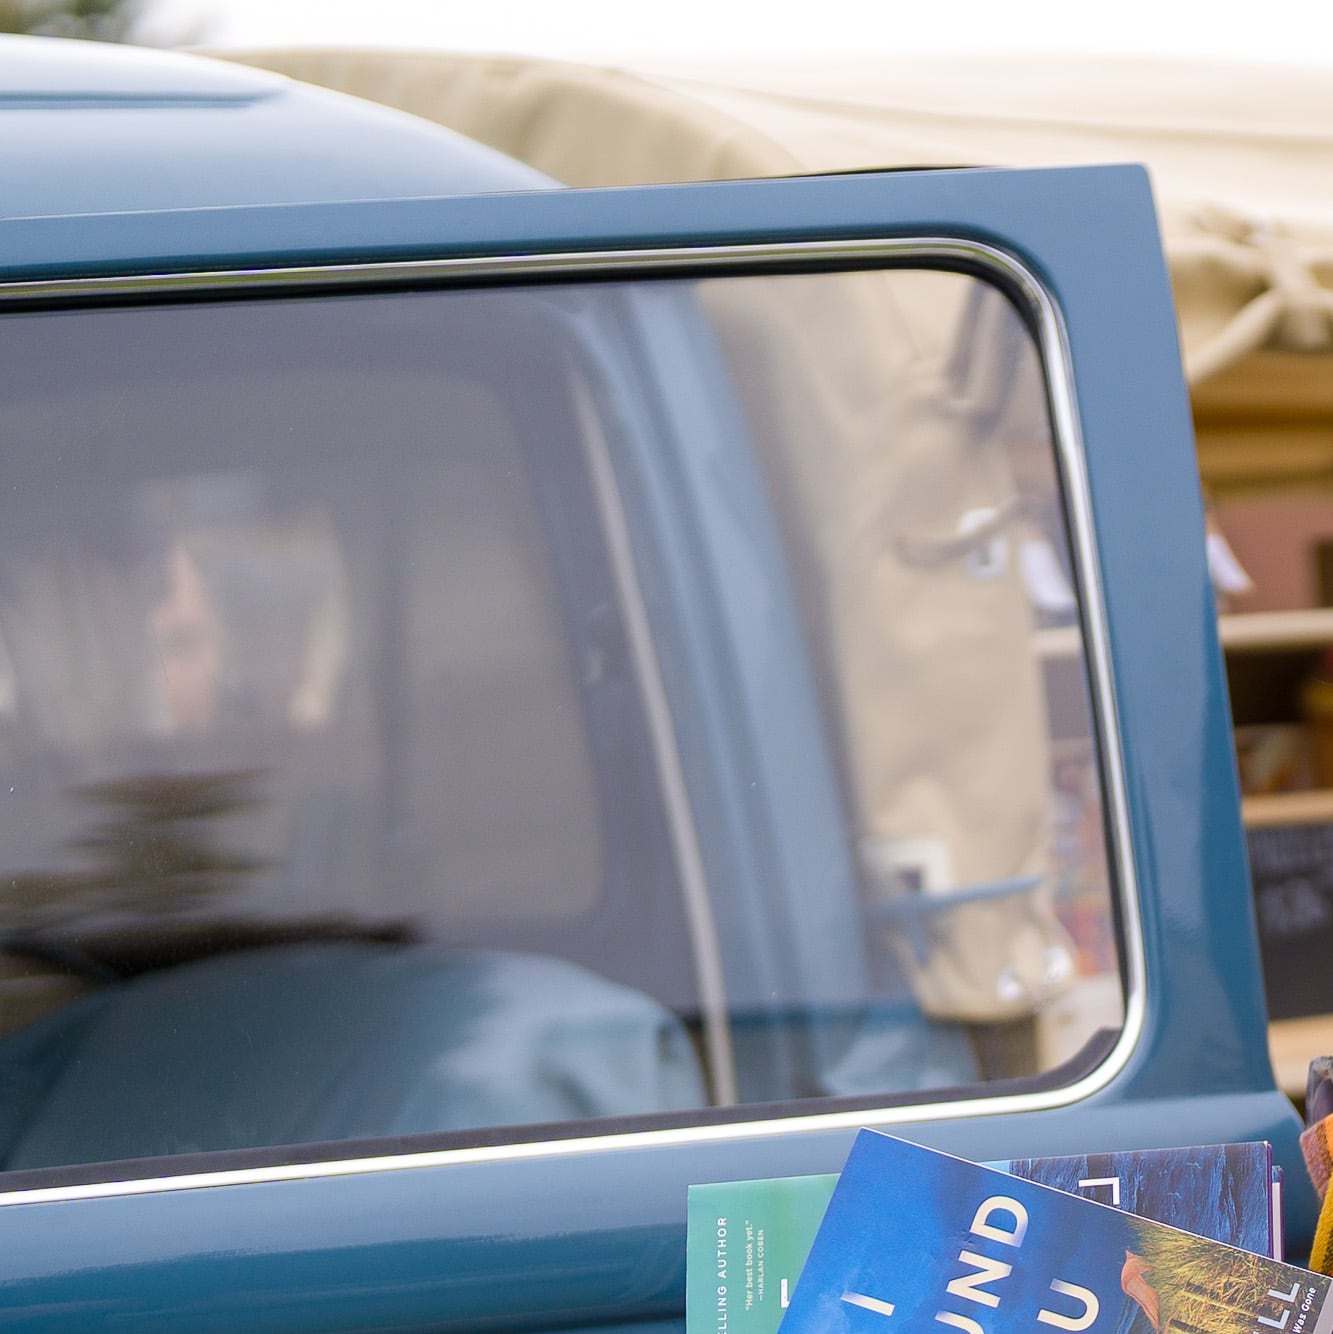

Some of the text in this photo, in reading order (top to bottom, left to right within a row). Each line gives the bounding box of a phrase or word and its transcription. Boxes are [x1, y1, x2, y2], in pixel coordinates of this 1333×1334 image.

[717, 1216, 728, 1279] AUTHOR
[745, 1243, 753, 1266] book
[757, 1229, 765, 1258] COBEN
[745, 1268, 753, 1288] best
[839, 1290, 896, 1317] I
[1291, 1313, 1307, 1334] Was
[1301, 1287, 1317, 1312] Gone
